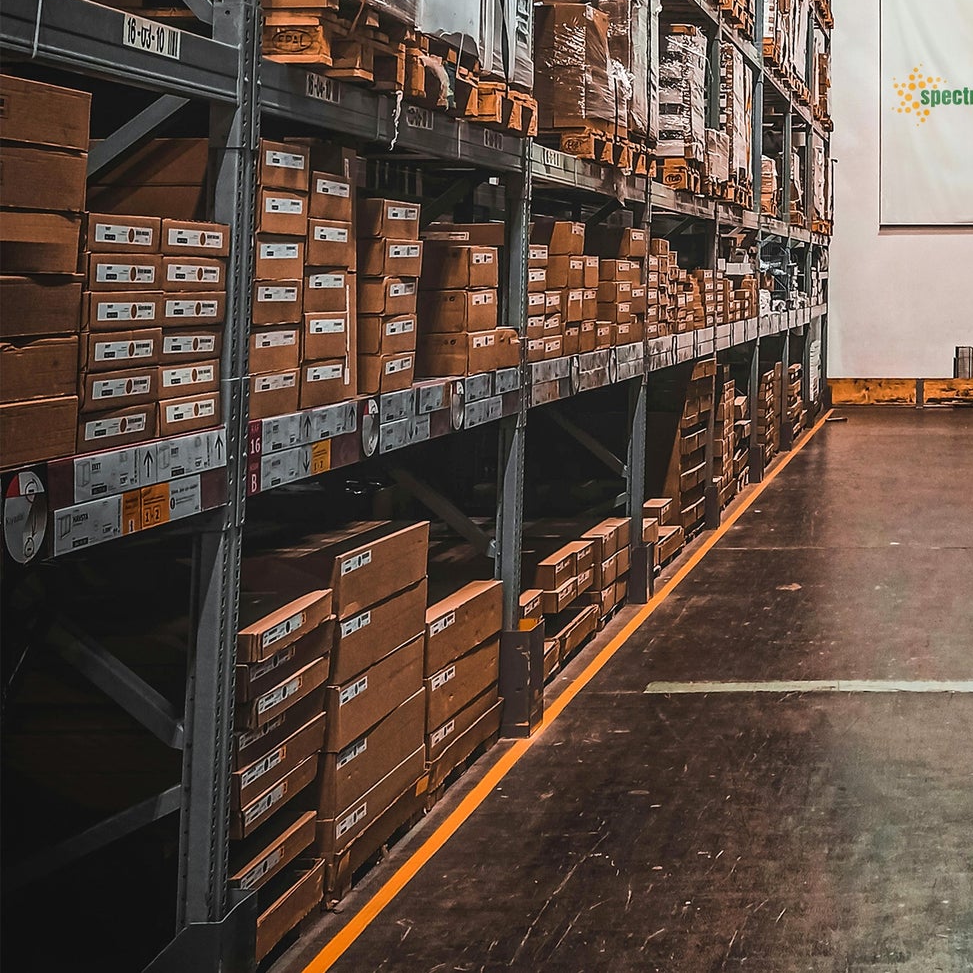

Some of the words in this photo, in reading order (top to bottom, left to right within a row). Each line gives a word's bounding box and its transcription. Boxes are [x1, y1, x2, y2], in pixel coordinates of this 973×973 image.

[128, 17, 165, 53] 16-03-10
[250, 437, 261, 454] 16
[251, 473, 258, 493] B
